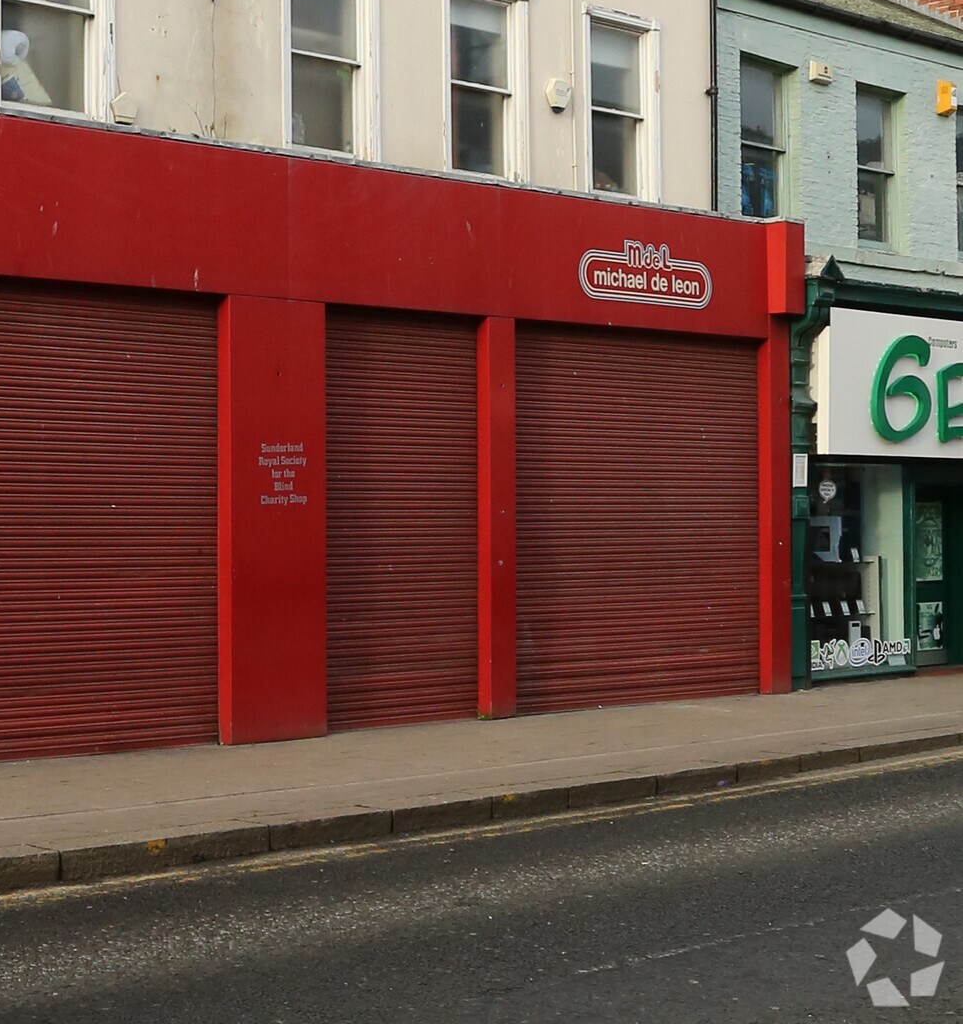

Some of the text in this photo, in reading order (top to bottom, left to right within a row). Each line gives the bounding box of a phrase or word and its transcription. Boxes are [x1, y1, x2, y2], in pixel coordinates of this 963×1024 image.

[593, 267, 700, 296] michael de leon
[261, 443, 304, 453] Sunderland
[258, 456, 307, 467] Royal Society
[271, 469, 295, 478] for the
[274, 482, 293, 491] Blind
[260, 494, 307, 506] Charity Shop
[883, 641, 903, 653] AMD
